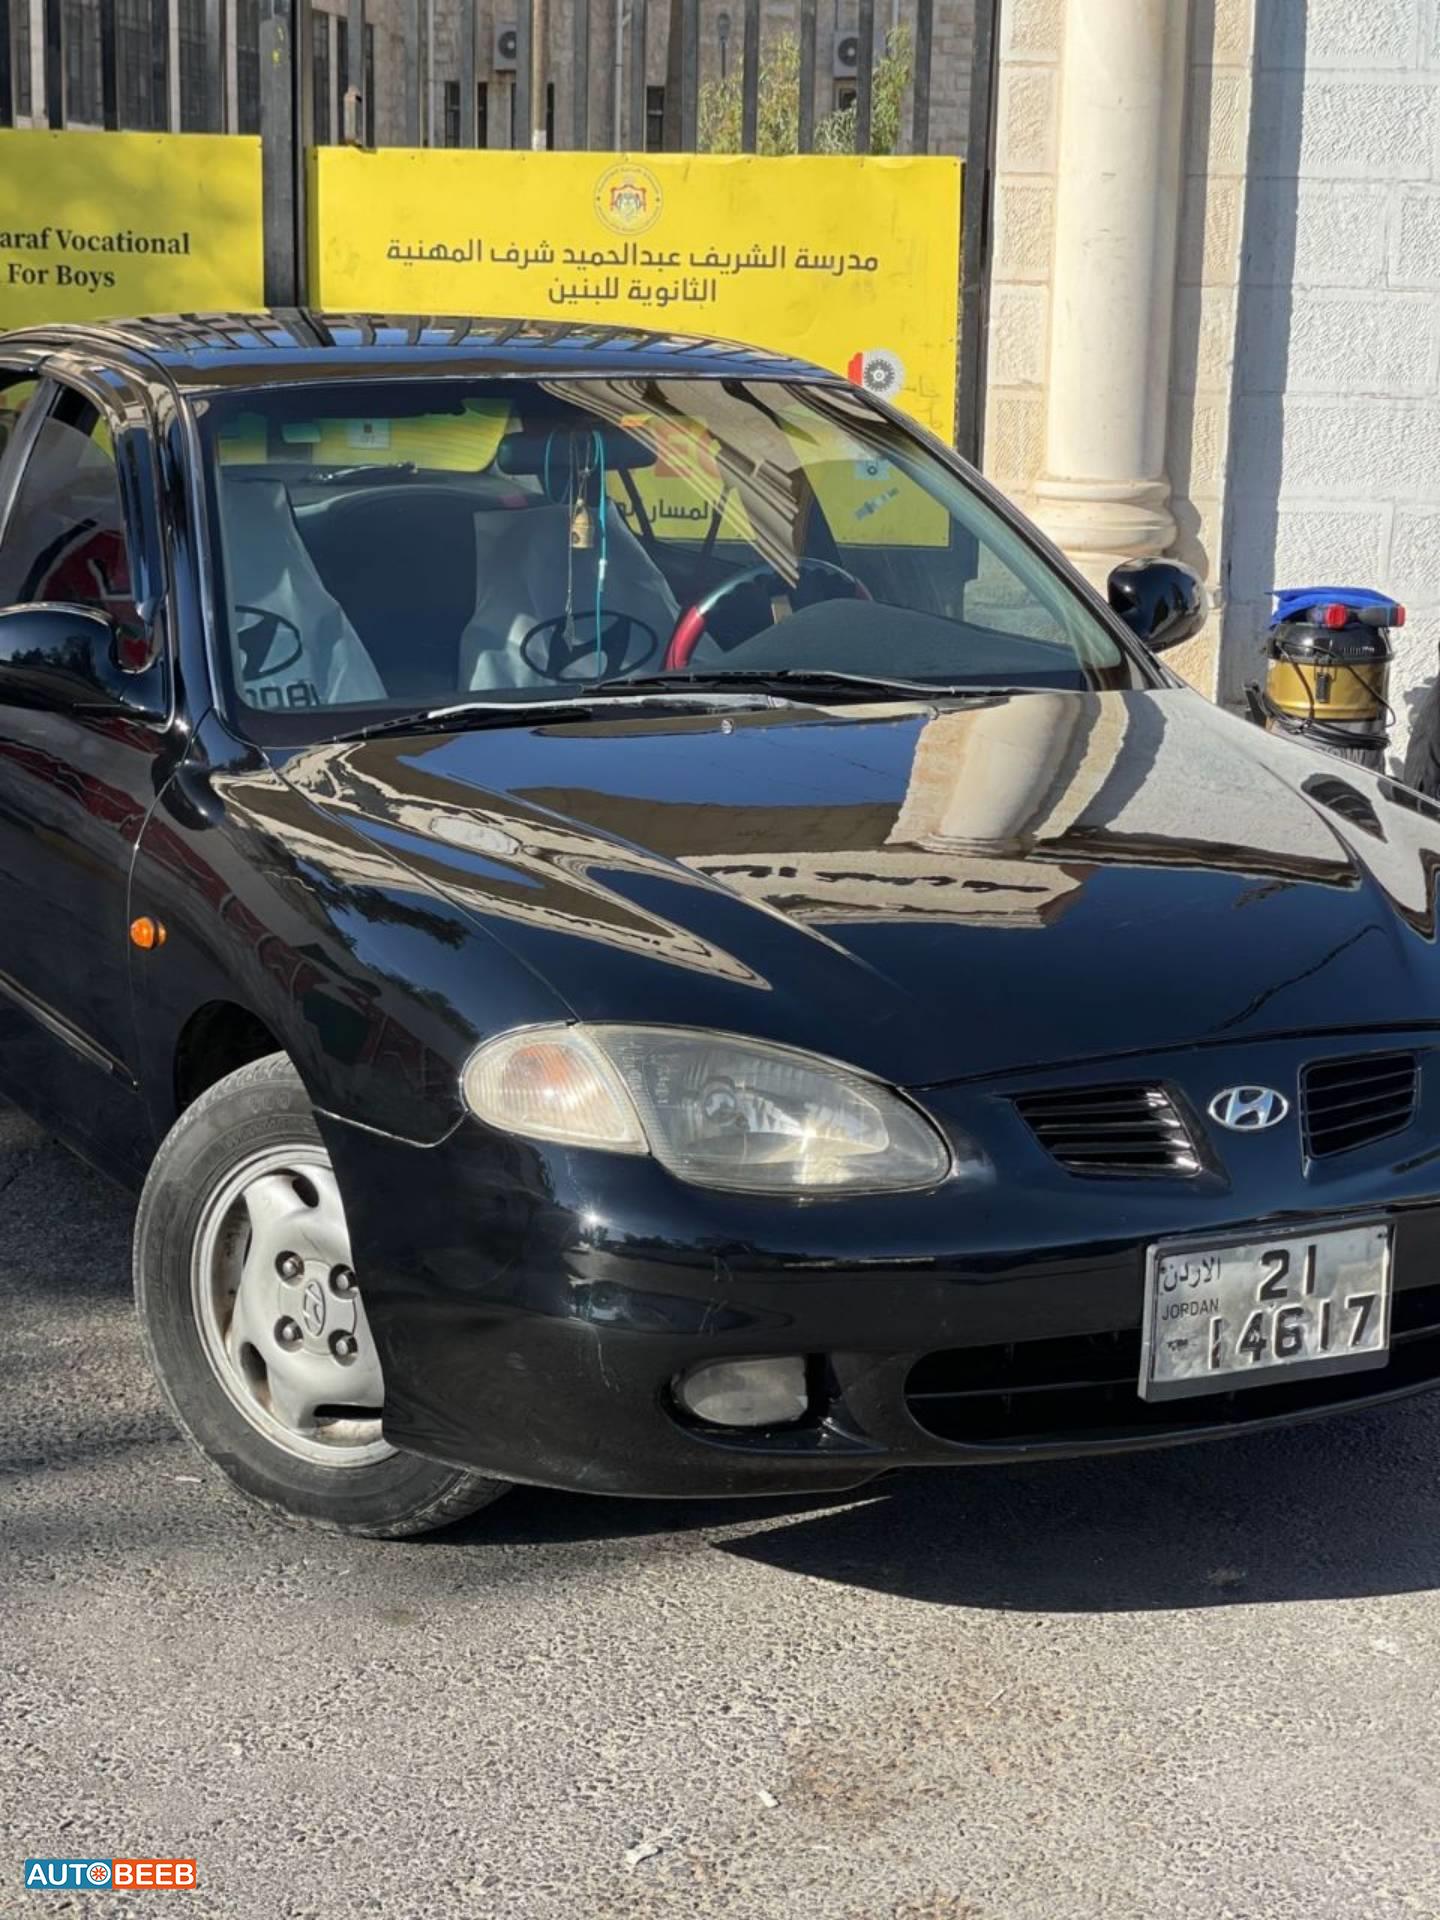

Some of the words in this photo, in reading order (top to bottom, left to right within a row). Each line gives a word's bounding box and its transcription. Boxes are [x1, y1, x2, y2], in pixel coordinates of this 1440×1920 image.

[56, 229, 190, 255] Vocational
[386, 238, 482, 267] المهنية
[490, 239, 554, 270] شرف
[690, 243, 786, 275] الشريف
[794, 247, 879, 277] مدرسة
[7, 262, 49, 285] For
[56, 264, 116, 293] Boys
[549, 276, 619, 305] للبنين
[628, 277, 716, 308] الثانوية
[1258, 1244, 1317, 1301] 21
[1161, 1299, 1220, 1321] JORDAN
[1208, 1291, 1378, 1370] 14617
